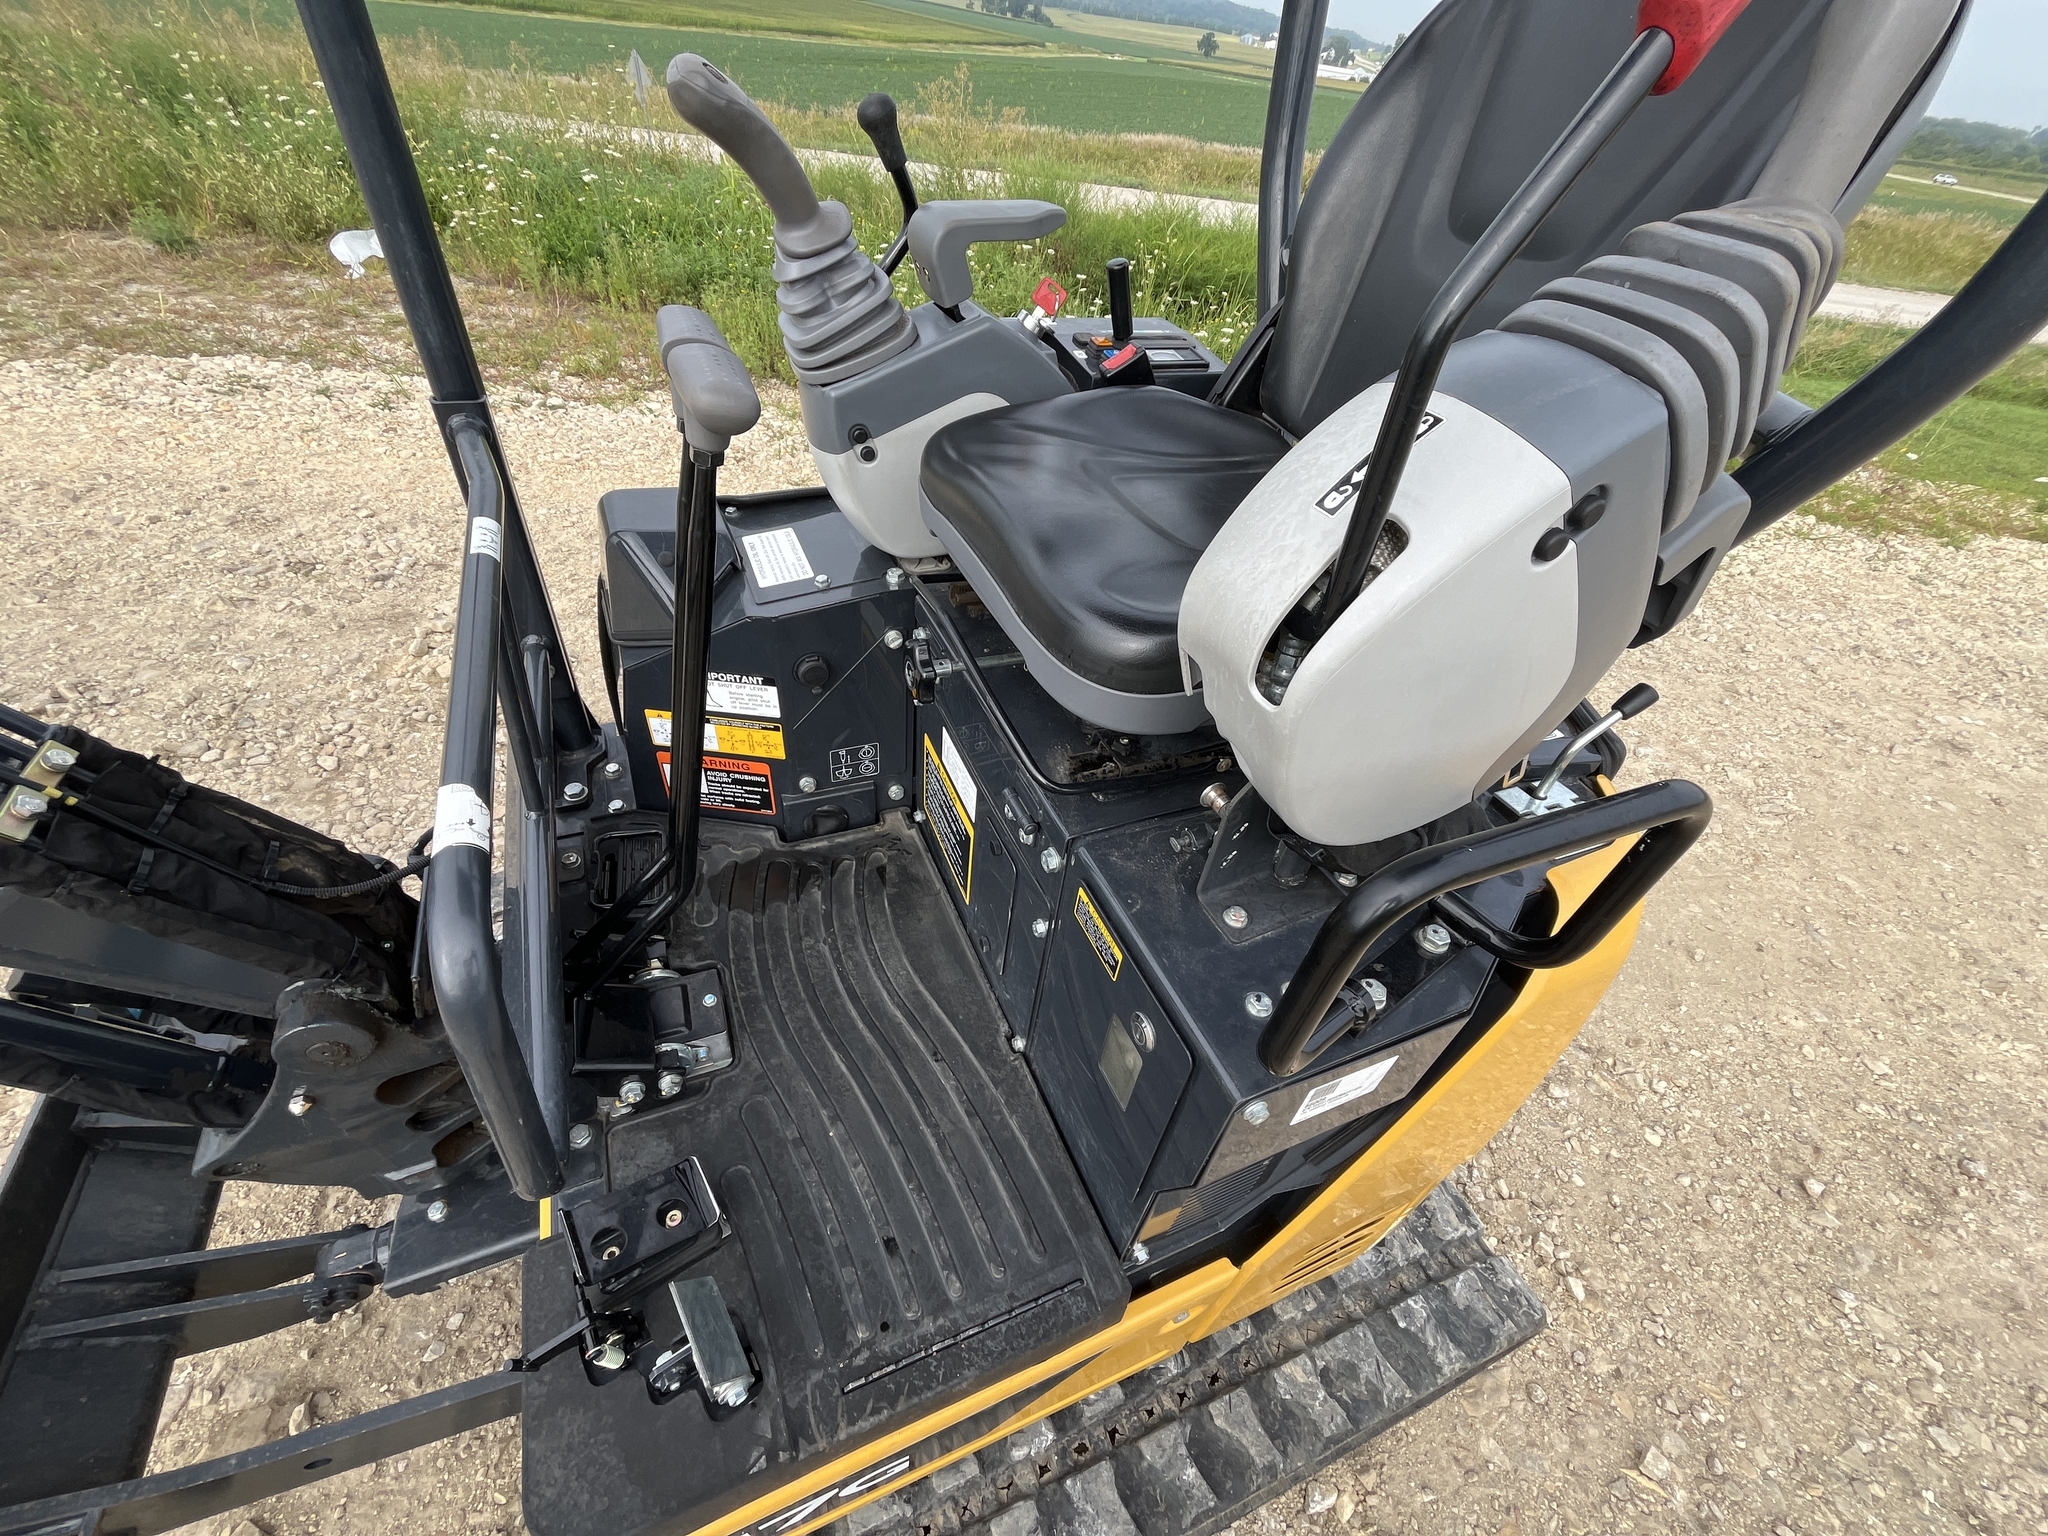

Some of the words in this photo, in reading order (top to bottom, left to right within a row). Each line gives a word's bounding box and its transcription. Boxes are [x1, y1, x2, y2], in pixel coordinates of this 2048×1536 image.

[708, 672, 763, 685] PORTANT
[702, 758, 750, 771] ARNING
[730, 773, 766, 782] CRUSHING
[740, 1455, 910, 1536] 7G
